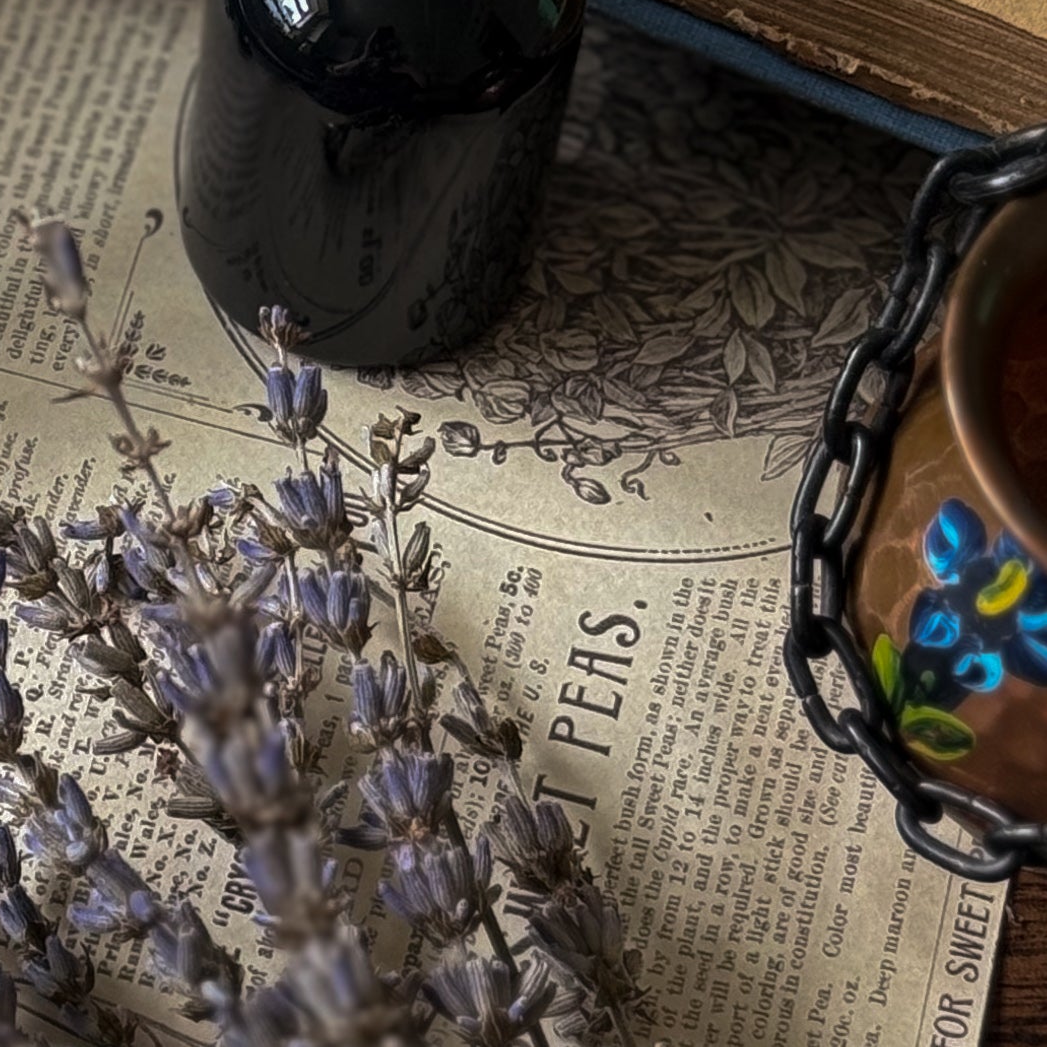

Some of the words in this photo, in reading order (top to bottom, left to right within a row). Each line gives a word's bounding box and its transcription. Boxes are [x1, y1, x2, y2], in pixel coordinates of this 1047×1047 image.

[6, 279, 47, 360] delightful
[498, 565, 525, 597] 5c.
[484, 602, 515, 652] Peas,
[549, 599, 649, 757] PEAS.
[650, 635, 680, 696] shown
[671, 640, 699, 707] neither
[626, 730, 657, 782] form,
[651, 715, 682, 769] Peas:
[652, 804, 680, 863] Cupid
[670, 753, 694, 801] race.
[695, 627, 727, 703] average
[692, 724, 723, 784] inches
[613, 786, 641, 832] bush
[637, 774, 666, 829] Sweet
[676, 900, 707, 959] plant,
[713, 742, 740, 809] proper
[746, 619, 772, 668] treat
[684, 794, 706, 820] 14
[774, 761, 803, 828] should
[668, 859, 690, 886] 12
[693, 949, 715, 993] seed
[715, 853, 740, 897] row,
[733, 763, 758, 817] make
[727, 859, 758, 943] required.
[747, 777, 777, 840] Grown
[763, 836, 786, 885] stick
[782, 846, 829, 971] constitution.
[818, 786, 841, 827] (See
[751, 953, 785, 1041] coloring,
[787, 830, 809, 883] good
[807, 983, 834, 1025] Pea.
[821, 903, 849, 958] Color
[839, 844, 863, 894] most
[867, 958, 898, 1007] Deep
[883, 878, 912, 954] maroon
[945, 883, 994, 983] SWEET
